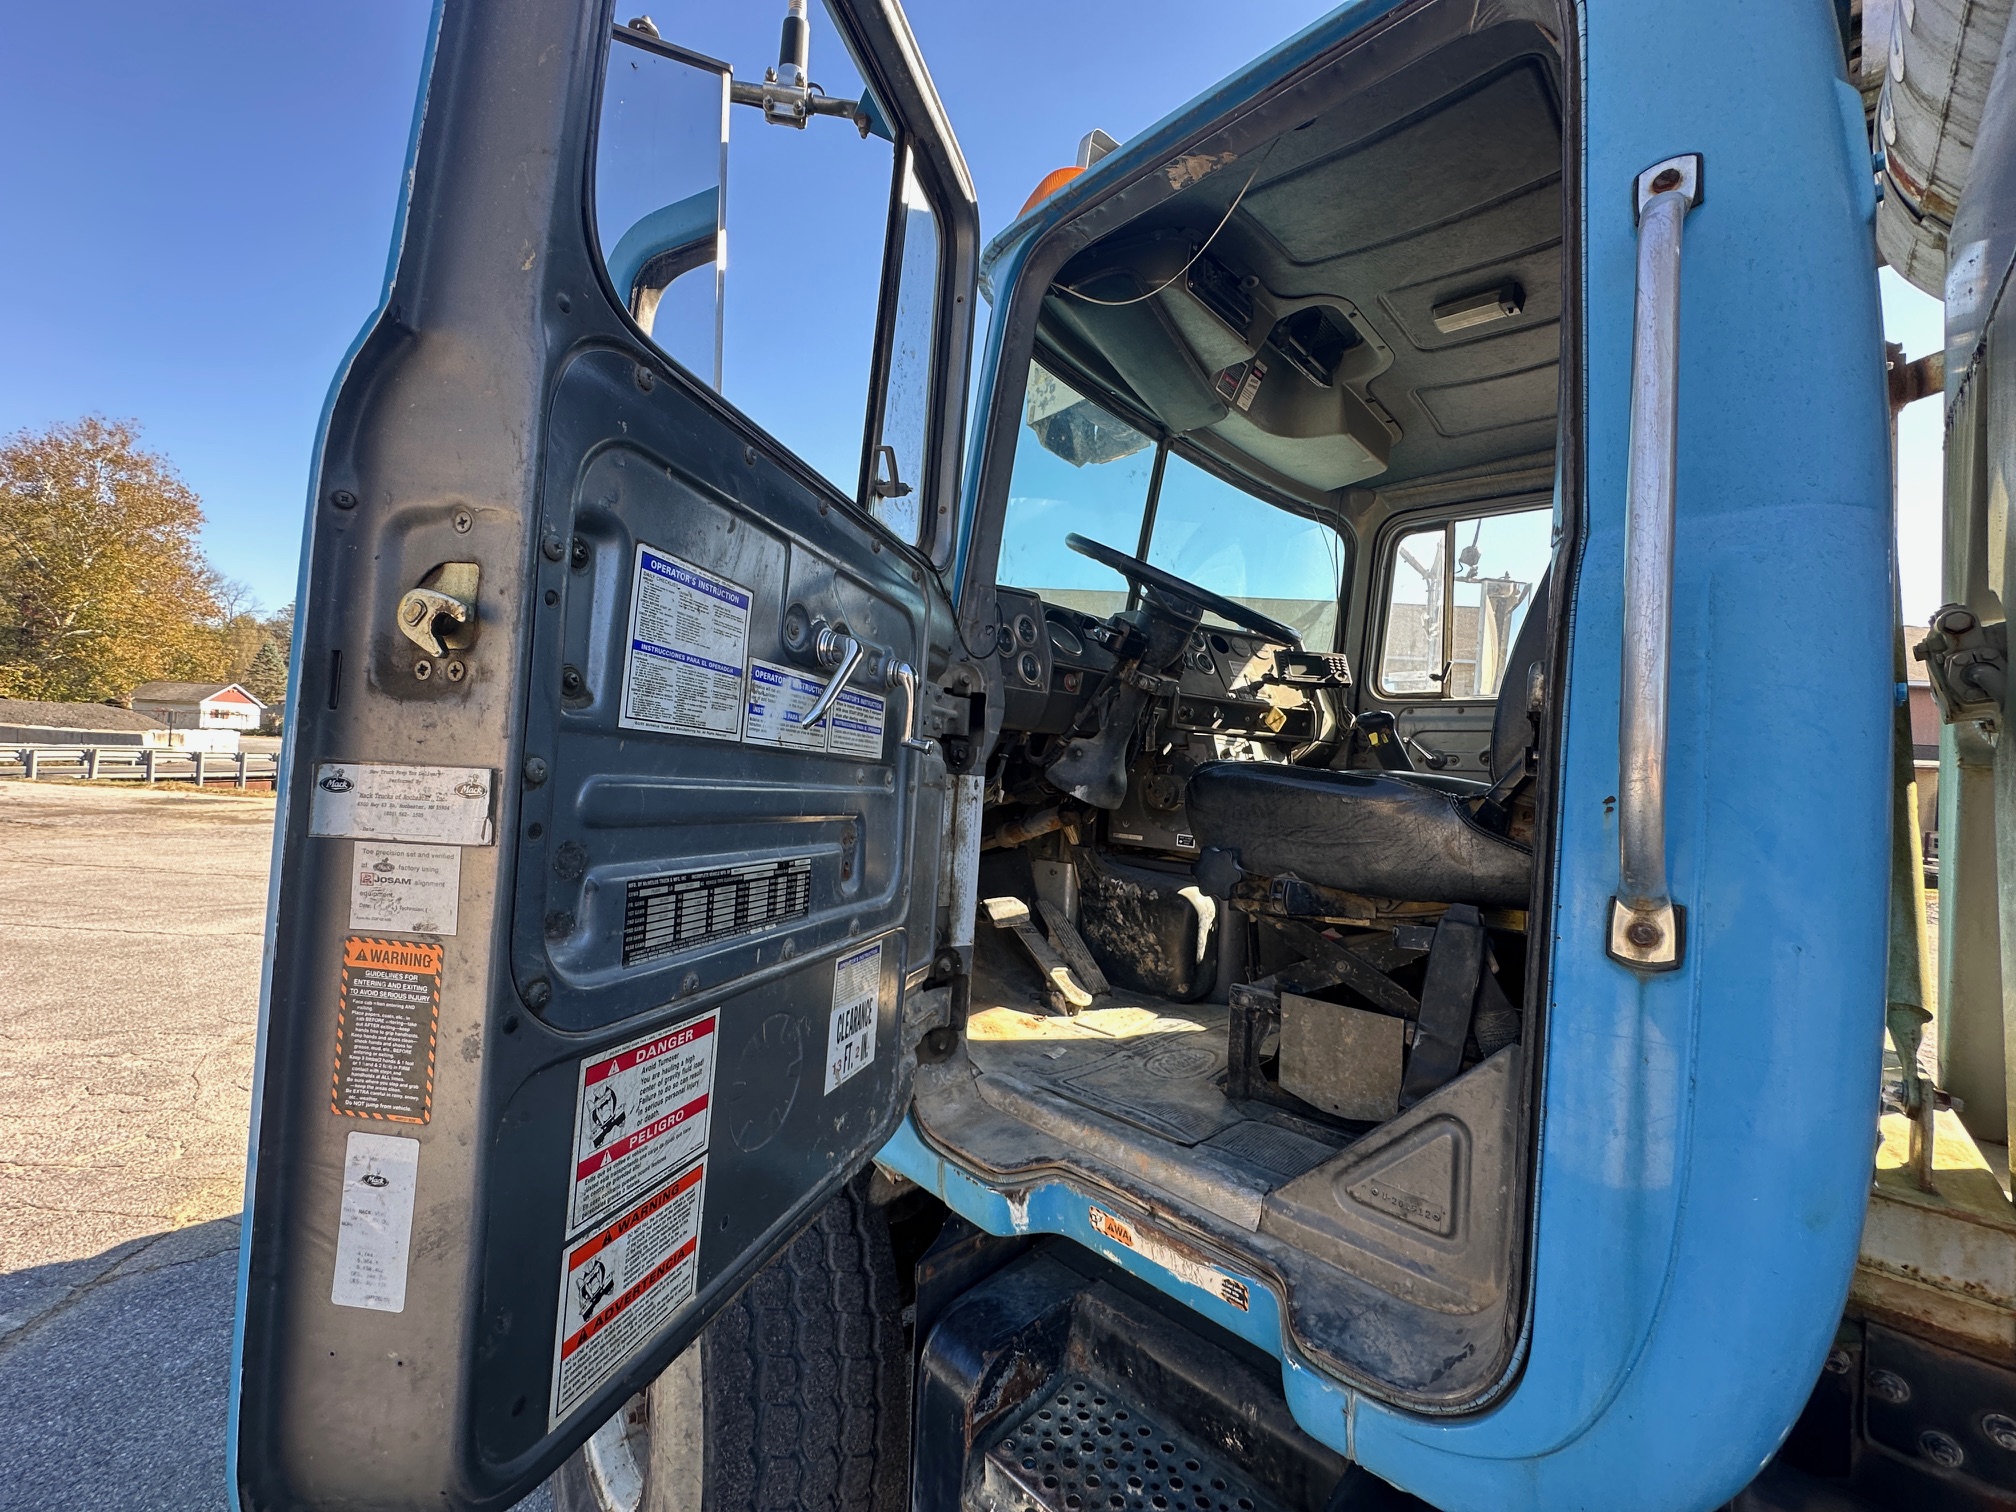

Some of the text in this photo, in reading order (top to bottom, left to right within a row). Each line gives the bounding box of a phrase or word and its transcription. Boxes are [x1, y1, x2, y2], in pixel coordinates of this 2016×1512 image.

[650, 559, 695, 586] OPERATOR'S
[698, 579, 739, 603] INSTRUCTION
[641, 643, 685, 660] INSTRUCCIONES
[686, 655, 700, 664] PARA
[326, 778, 347, 788] Mack
[460, 785, 482, 794] Mack
[375, 848, 404, 857] precision
[374, 875, 411, 884] JOSAM
[365, 969, 403, 979] GUIDELINES
[369, 948, 431, 968] WARNING
[353, 978, 386, 987] ENTERING
[835, 996, 873, 1045] CLEARANCE
[635, 1028, 693, 1063] DANGER
[842, 1039, 855, 1074] FT.
[855, 1044, 860, 1059] 2
[639, 1073, 650, 1086] You
[651, 1070, 660, 1080] are
[661, 1060, 679, 1077] hauling
[684, 1053, 695, 1066] high
[639, 1057, 704, 1095] center of gravity fluid load!
[641, 1050, 679, 1075] Avoid Turnover
[638, 1090, 656, 1106] Failure
[657, 1087, 663, 1096] to
[664, 1084, 671, 1093] do
[679, 1075, 688, 1085] can
[689, 1067, 702, 1080] result
[644, 1097, 663, 1113] serious
[664, 1085, 685, 1104] personal
[686, 1078, 699, 1092] injury
[629, 1108, 684, 1149] PELIGRO
[636, 1108, 659, 1127] or death.
[609, 1156, 638, 1178] transportando
[639, 1152, 647, 1161] una
[647, 1145, 658, 1157] carga
[682, 1125, 691, 1134] tiene
[582, 1193, 589, 1202] un
[590, 1183, 605, 1197] centro
[605, 1179, 611, 1188] de
[612, 1167, 631, 1185] gravedad
[584, 1173, 595, 1186] Evite
[596, 1169, 605, 1180] que
[612, 1157, 626, 1169] voltee
[582, 1202, 588, 1211] En
[617, 1182, 679, 1235] WARNING
[593, 1245, 685, 1332] ADVERTENCIA
